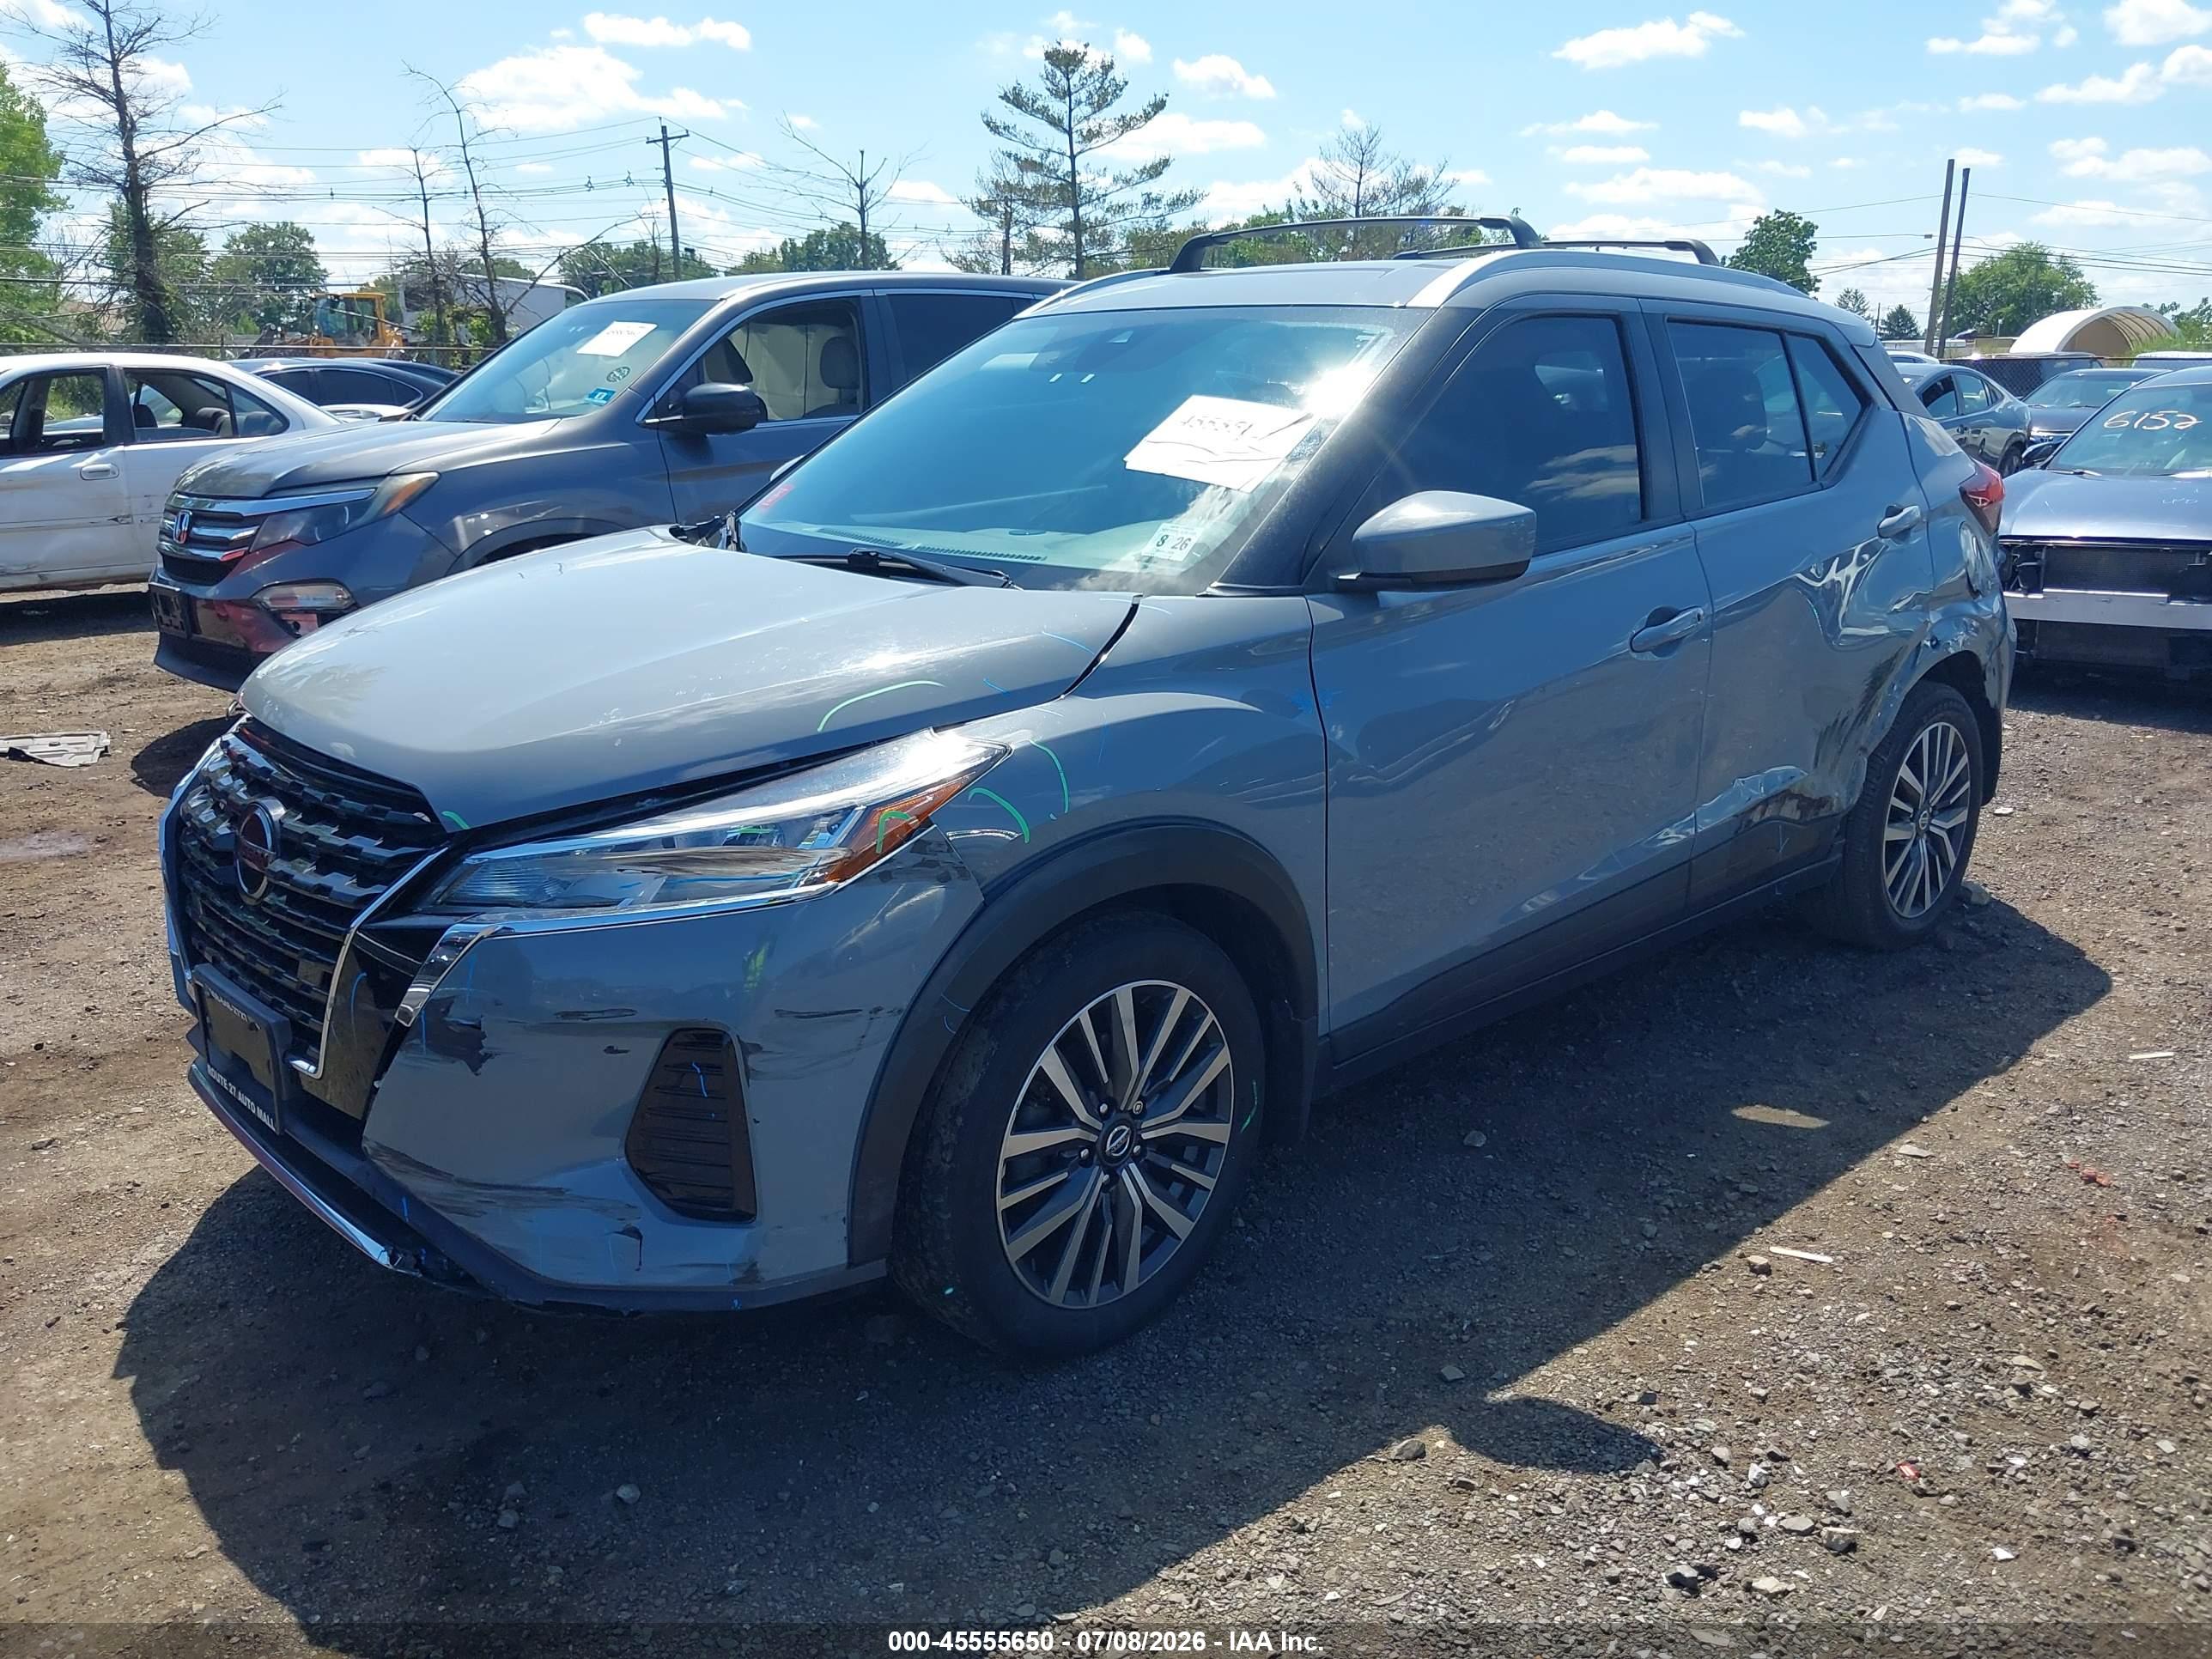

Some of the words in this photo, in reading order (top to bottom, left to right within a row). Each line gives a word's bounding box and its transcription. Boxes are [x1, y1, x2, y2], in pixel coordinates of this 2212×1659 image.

[2104, 410, 2203, 430] 6152
[1156, 534, 1170, 547] 8
[1170, 536, 1192, 551] 26
[207, 1064, 228, 1091] ROUTE
[238, 1090, 256, 1114] AUTO
[257, 1105, 276, 1132] MALL
